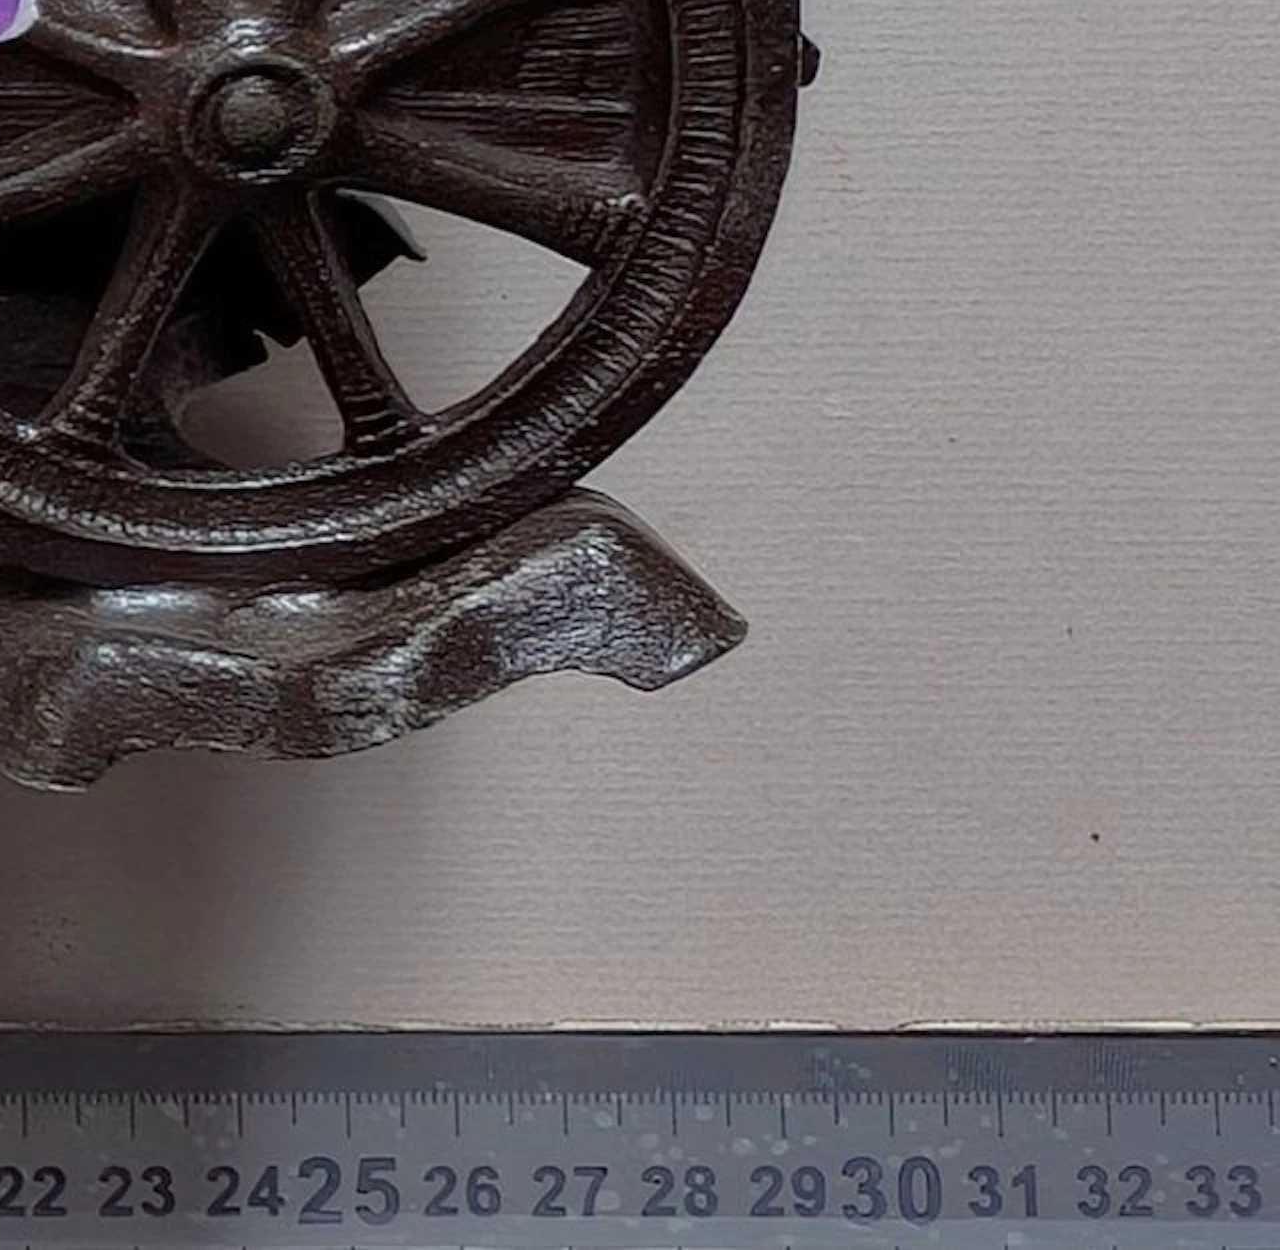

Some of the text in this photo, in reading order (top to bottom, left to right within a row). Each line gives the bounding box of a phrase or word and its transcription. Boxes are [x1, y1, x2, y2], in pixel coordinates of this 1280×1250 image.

[99, 1169, 176, 1221] 23
[207, 1168, 285, 1221] 24
[298, 1159, 400, 1228] 25
[424, 1168, 501, 1220] 26
[532, 1167, 608, 1220] 27
[640, 1167, 718, 1220] 28
[749, 1167, 825, 1219] 29
[842, 1157, 941, 1226] 30
[968, 1166, 1038, 1219] 31
[1077, 1166, 1154, 1219] 32
[1185, 1165, 1262, 1218] 33
